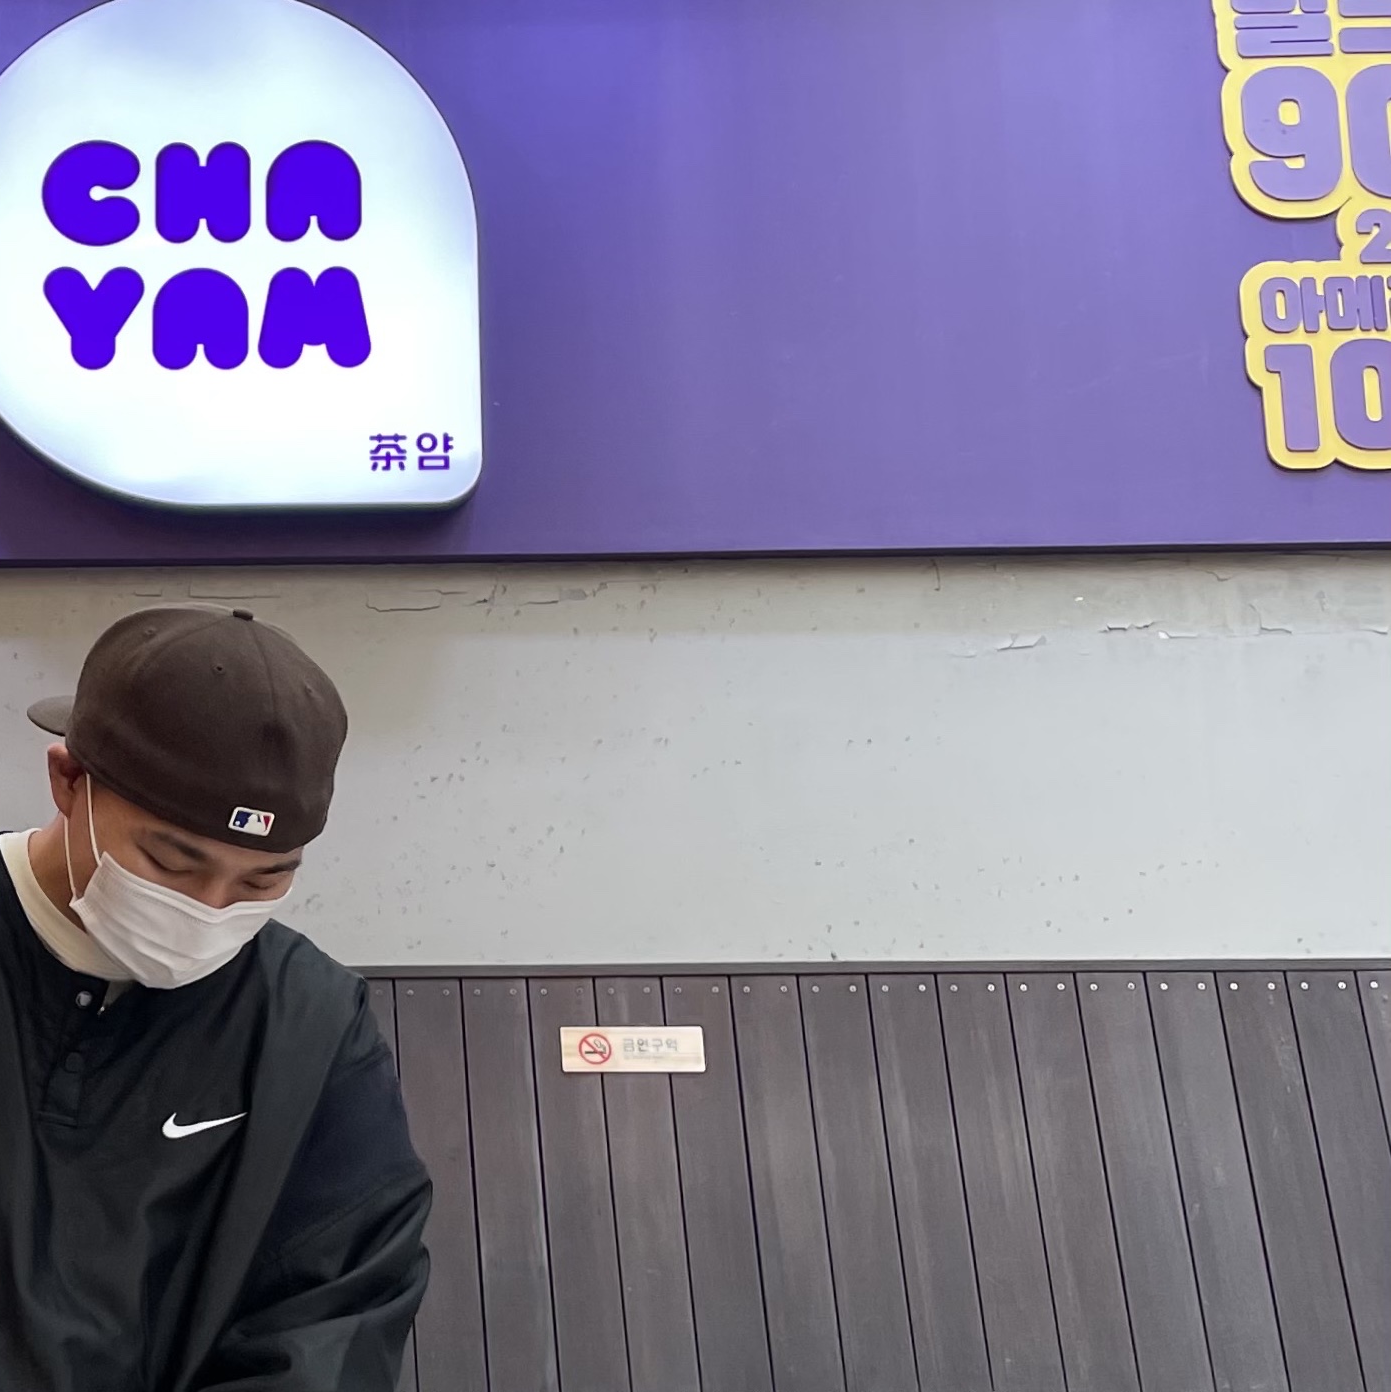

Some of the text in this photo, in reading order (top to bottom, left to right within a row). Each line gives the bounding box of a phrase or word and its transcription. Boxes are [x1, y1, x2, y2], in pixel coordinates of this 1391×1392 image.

[41, 139, 362, 246] CHA
[43, 266, 372, 370] YAM
[1259, 275, 1391, 333] 아메
